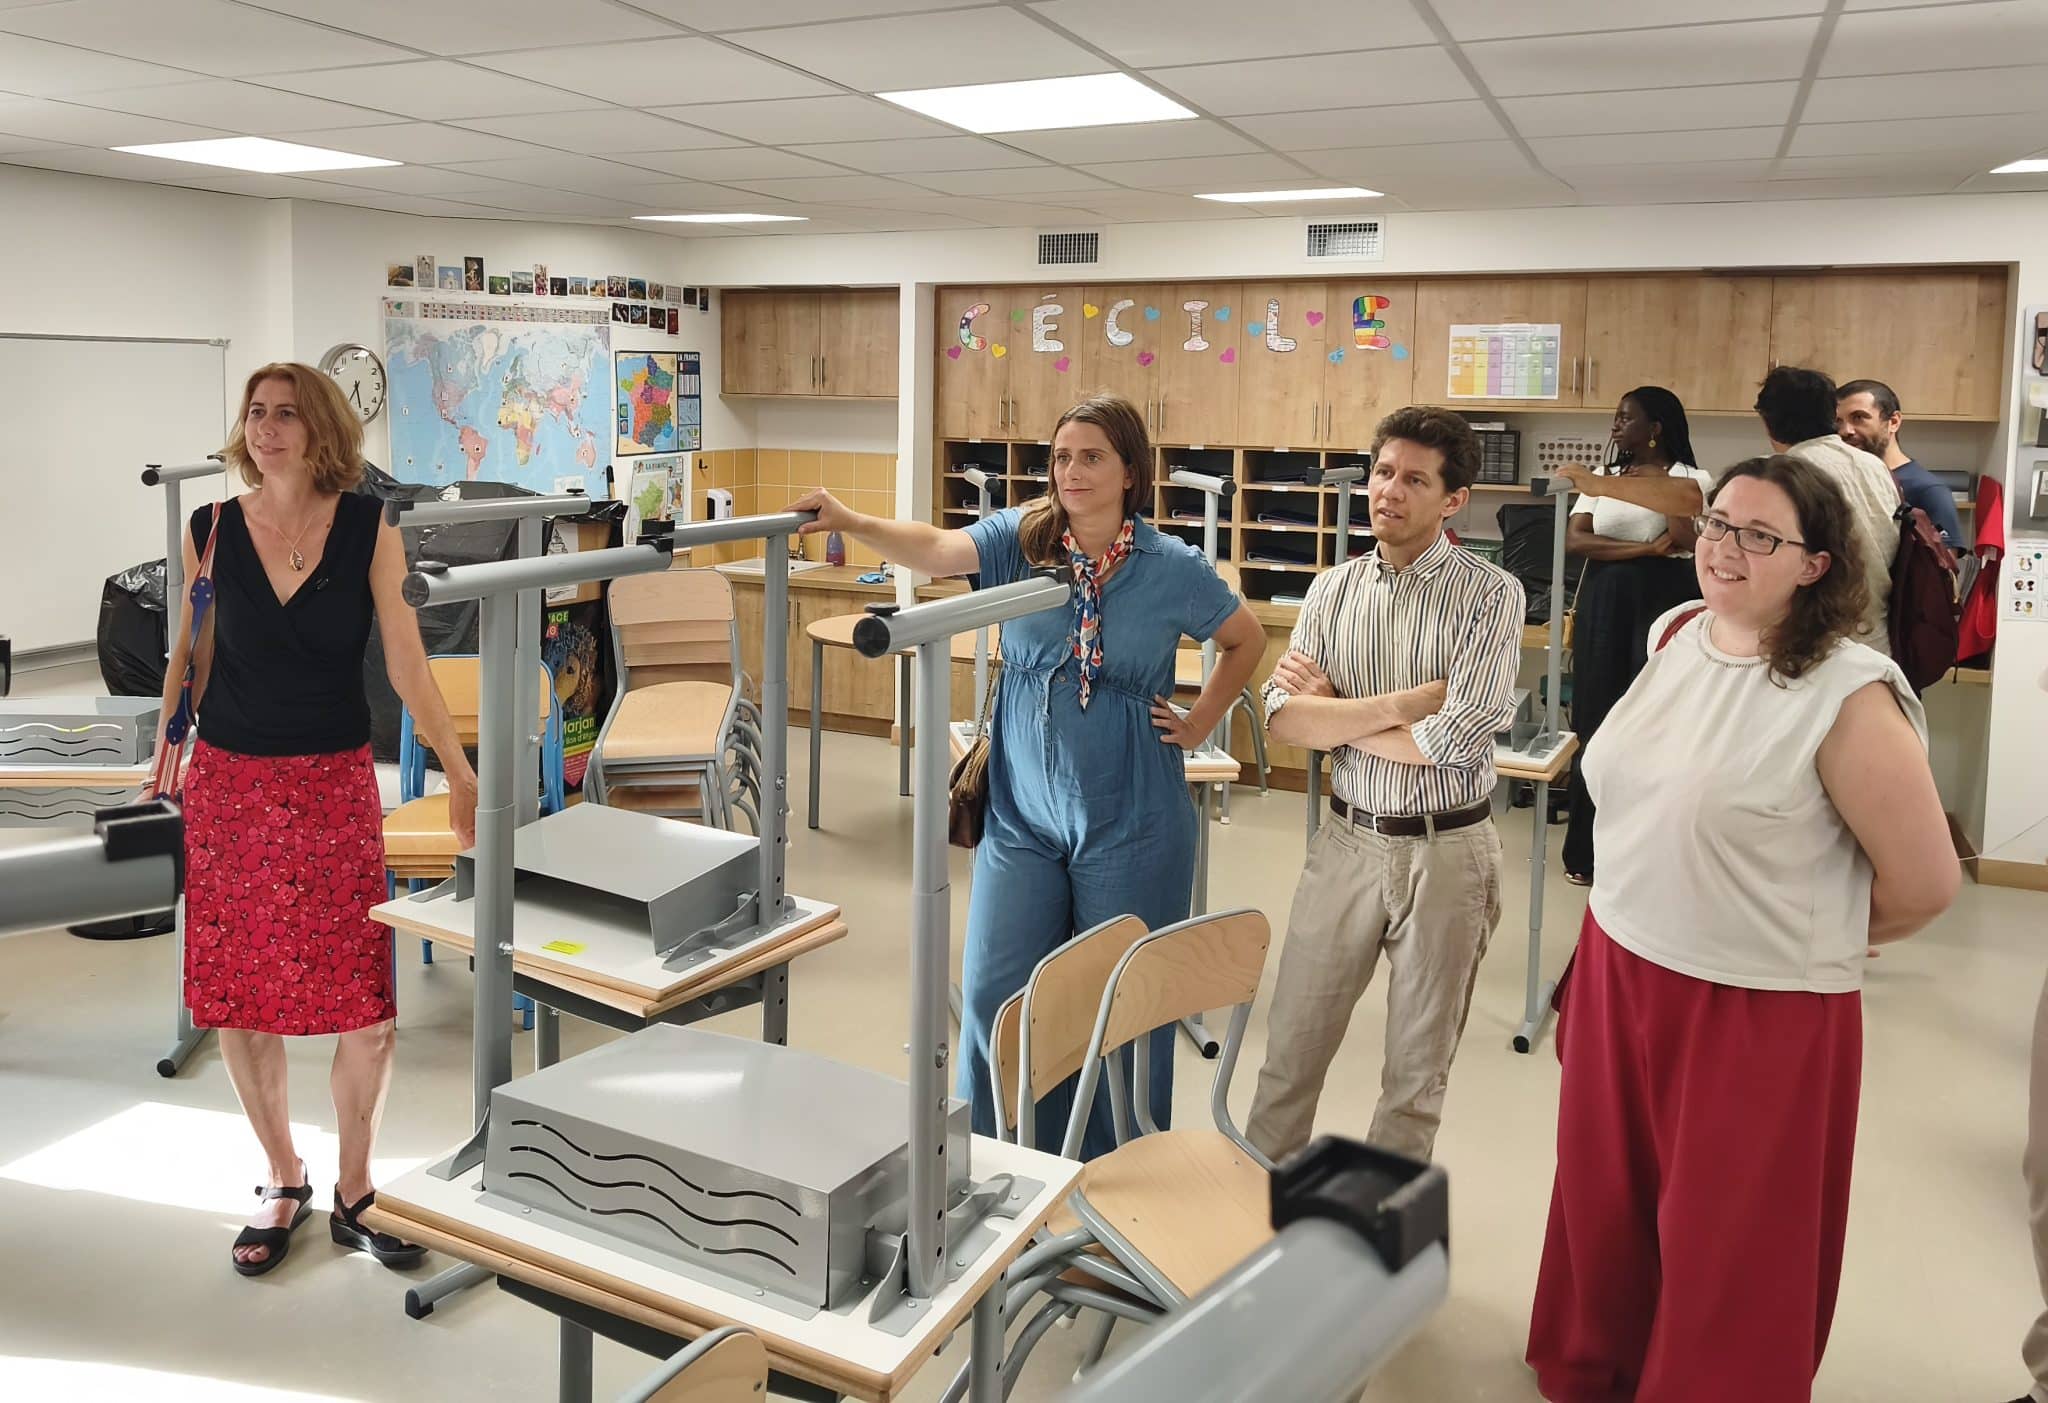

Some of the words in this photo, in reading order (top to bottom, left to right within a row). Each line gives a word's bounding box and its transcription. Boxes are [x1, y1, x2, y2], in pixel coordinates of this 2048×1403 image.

[371, 367, 377, 375] 2
[375, 382, 381, 390] 3
[371, 396, 377, 404] 4
[364, 407, 370, 415] 5
